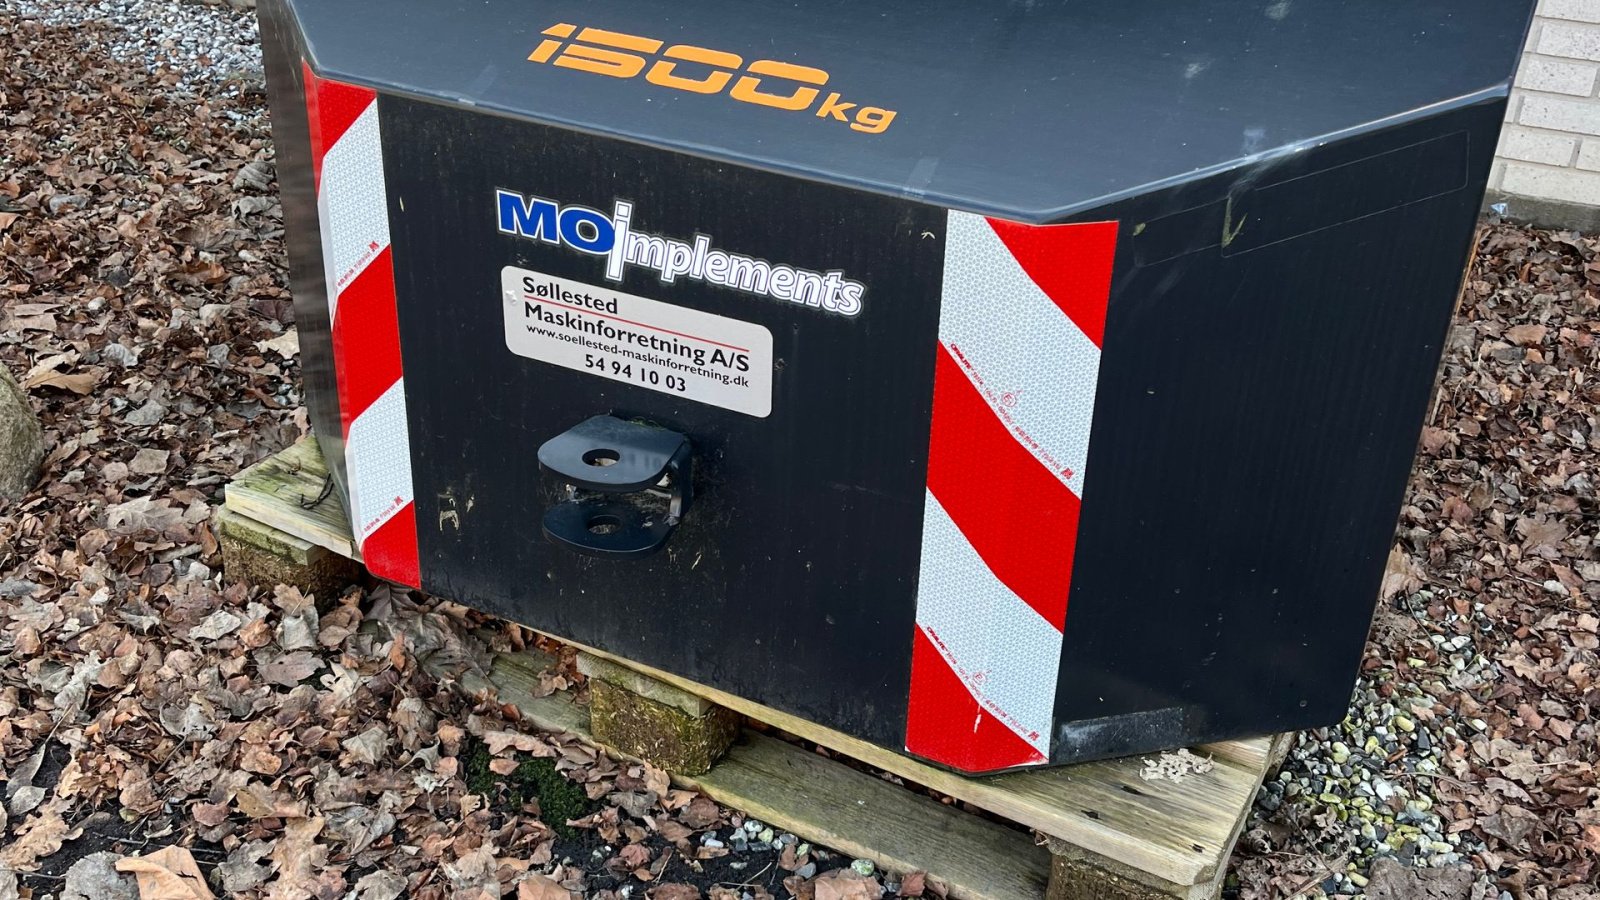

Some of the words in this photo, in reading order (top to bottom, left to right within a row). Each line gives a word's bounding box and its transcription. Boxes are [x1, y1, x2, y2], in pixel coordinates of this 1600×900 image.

[522, 276, 618, 315] Søllested
[524, 300, 706, 365] Maskinforretning
[709, 348, 751, 373] A/S
[525, 324, 750, 388] www.soellested-maskinforretning.dk
[584, 353, 606, 373] 54
[610, 359, 633, 379] 94
[639, 367, 660, 386] 10
[665, 374, 687, 392] 03
